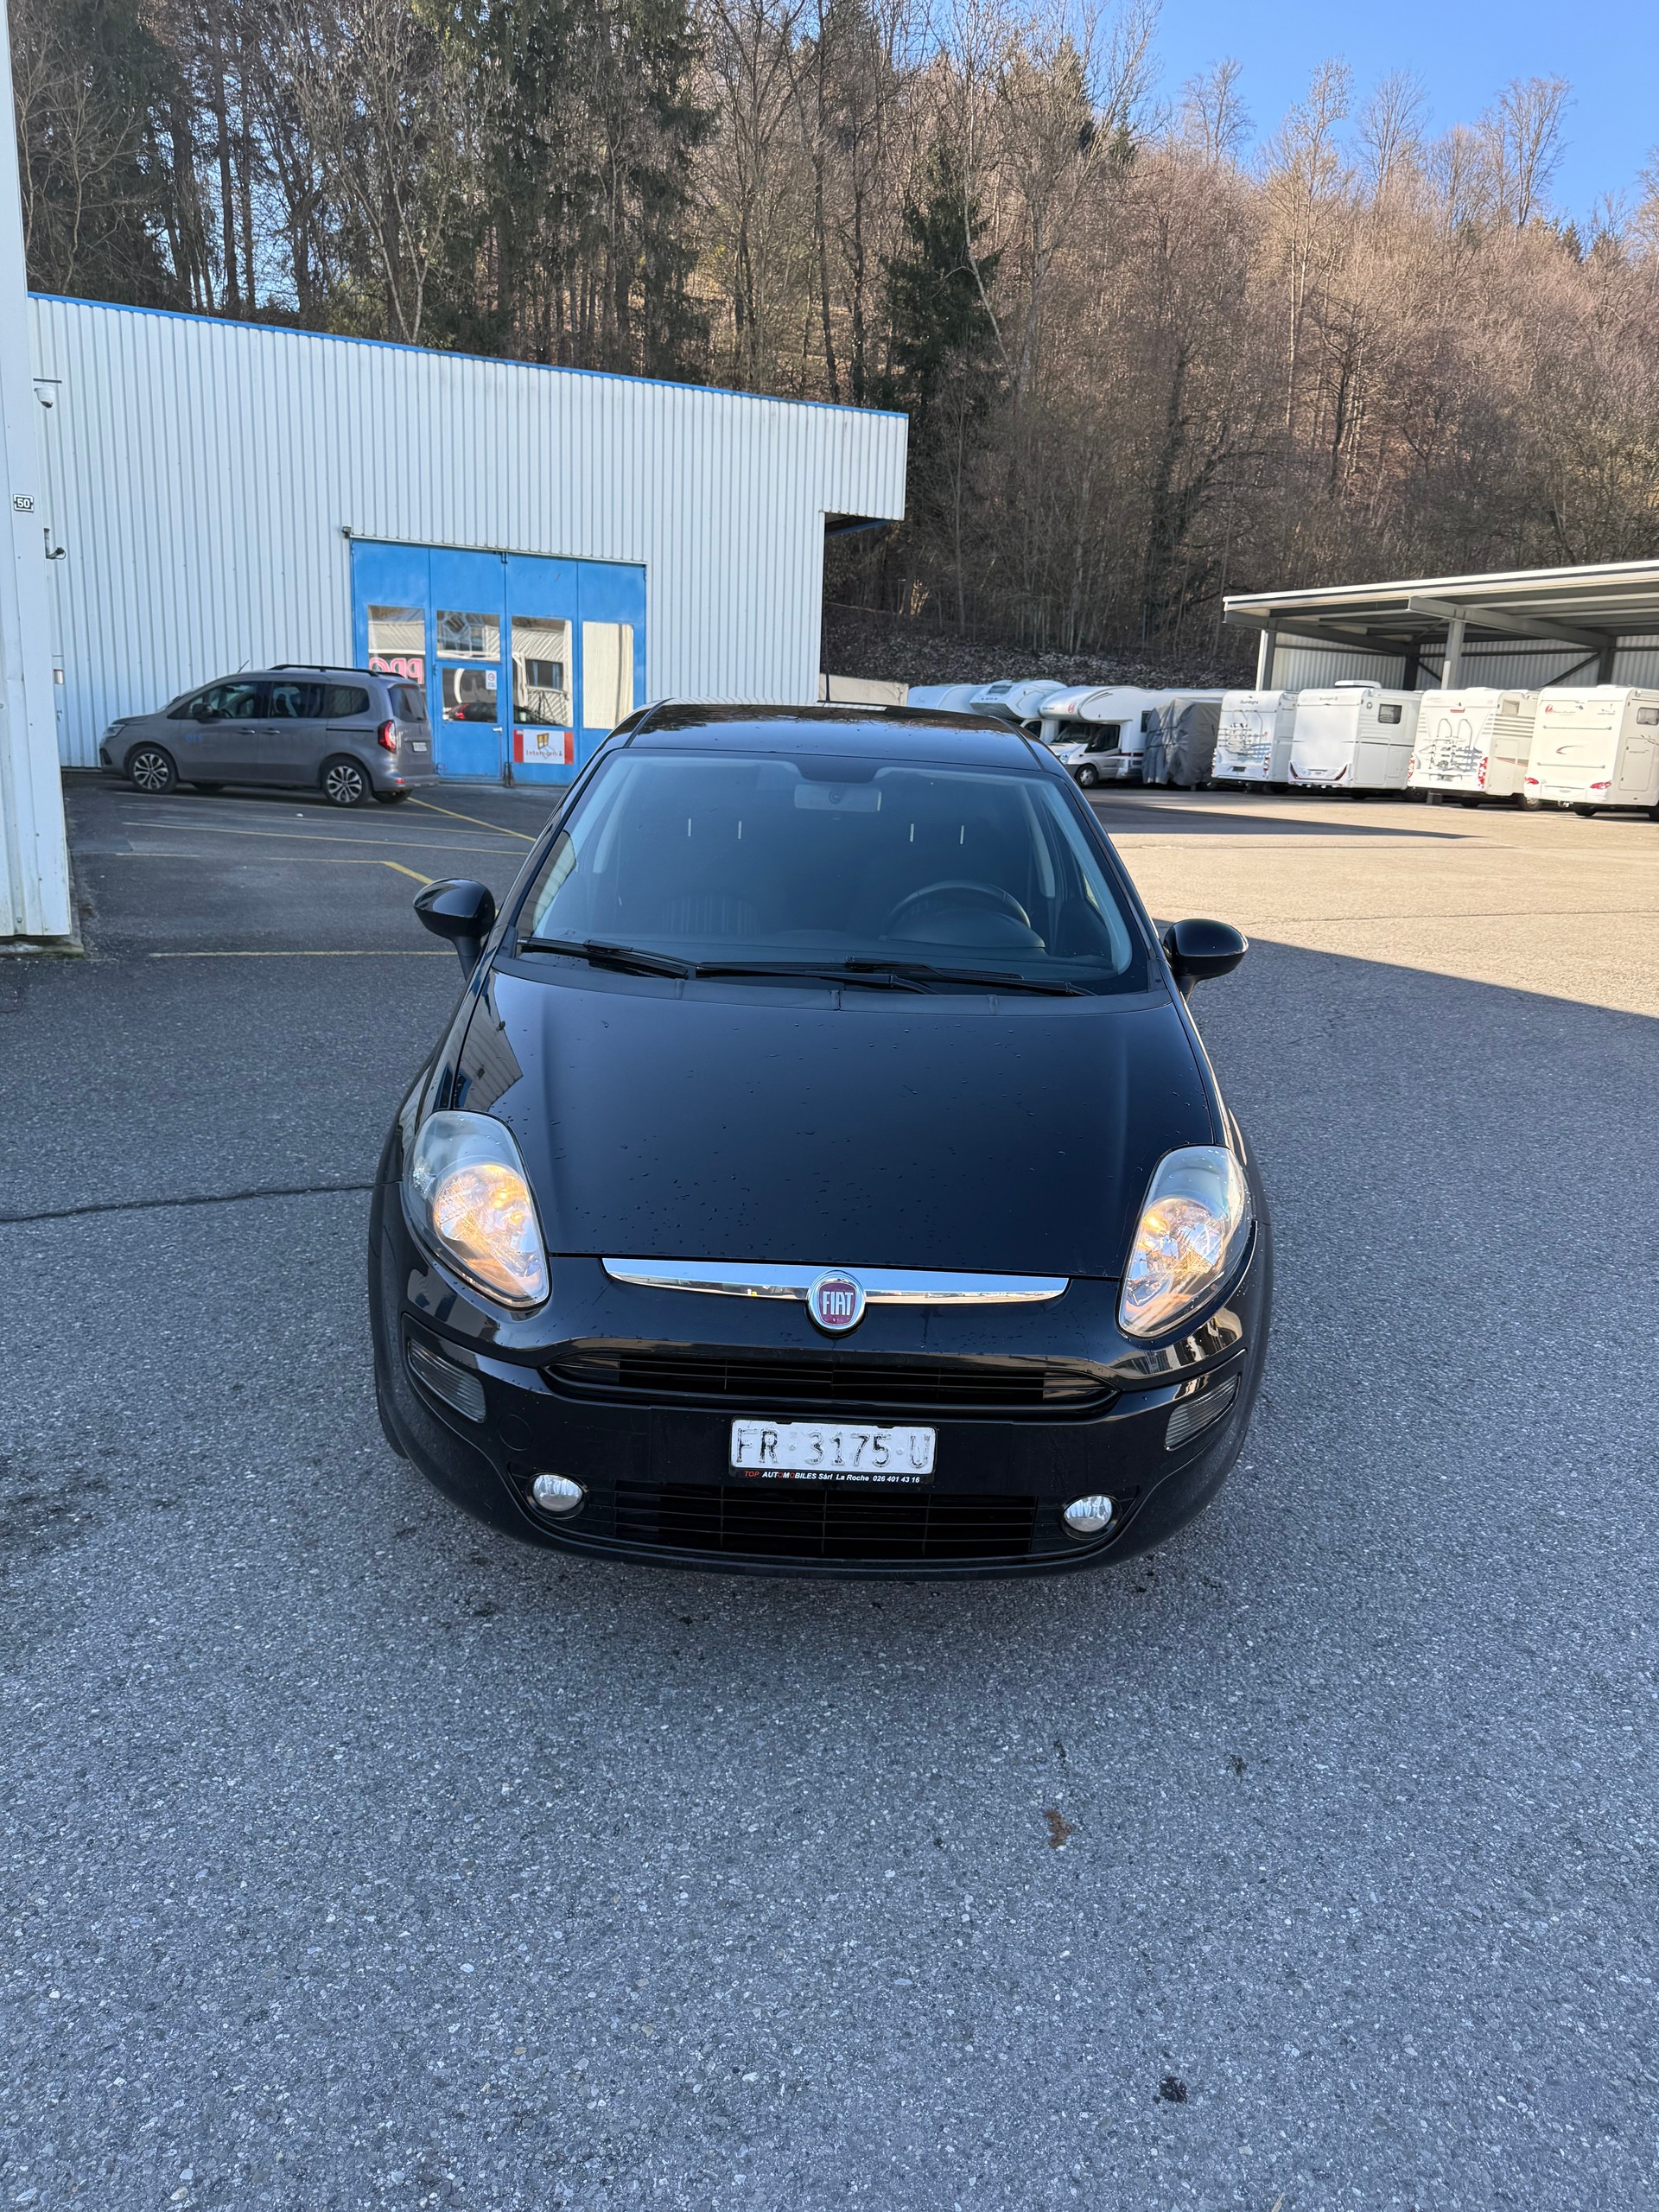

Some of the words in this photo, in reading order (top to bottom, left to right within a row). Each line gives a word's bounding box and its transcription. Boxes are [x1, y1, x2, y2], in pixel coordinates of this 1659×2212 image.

[17, 498, 30, 508] 50
[823, 1291, 854, 1316] FIAT
[736, 1428, 779, 1464] FR
[804, 1430, 892, 1467] 3175
[909, 1433, 931, 1469] U
[761, 1471, 817, 1479] AUTOMOBILES
